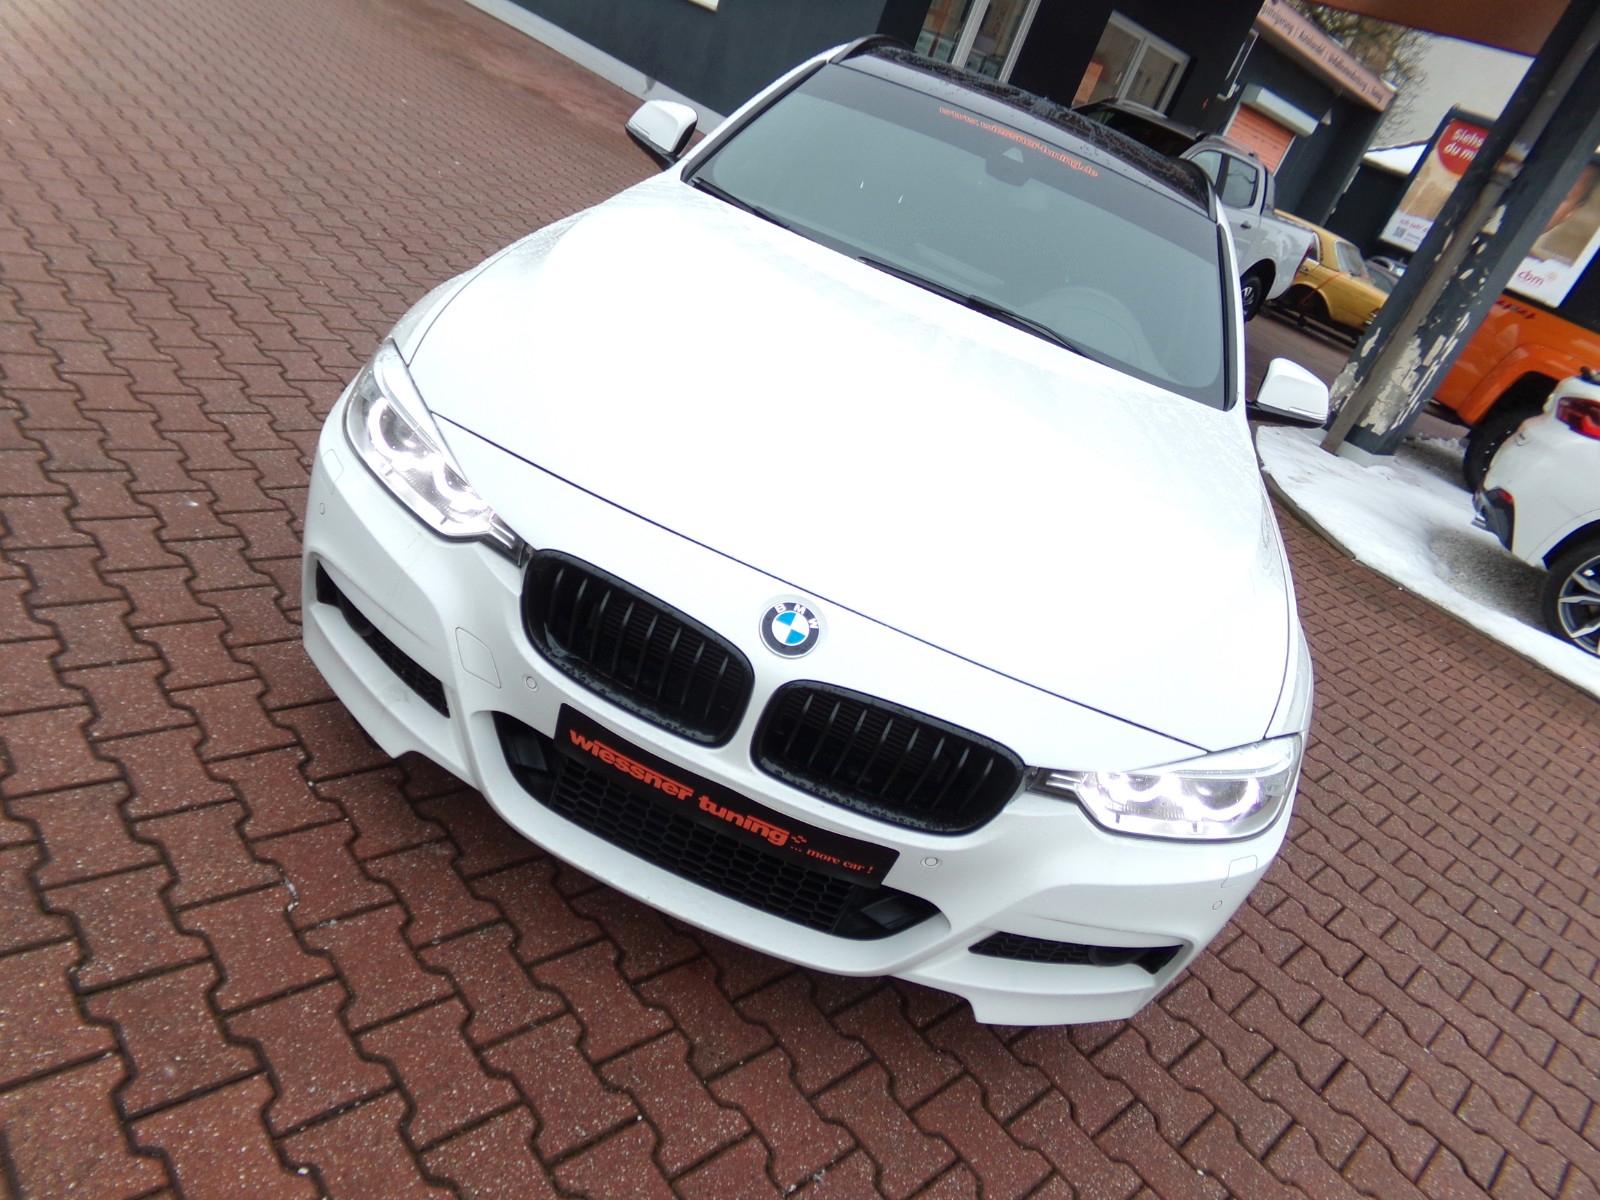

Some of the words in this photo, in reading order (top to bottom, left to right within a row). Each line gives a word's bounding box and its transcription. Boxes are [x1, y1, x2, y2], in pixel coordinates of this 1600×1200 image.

[774, 603, 819, 629] BMW
[569, 729, 695, 801] wiessner
[698, 795, 791, 847] tuning
[805, 848, 841, 865] more
[842, 860, 866, 872] car
